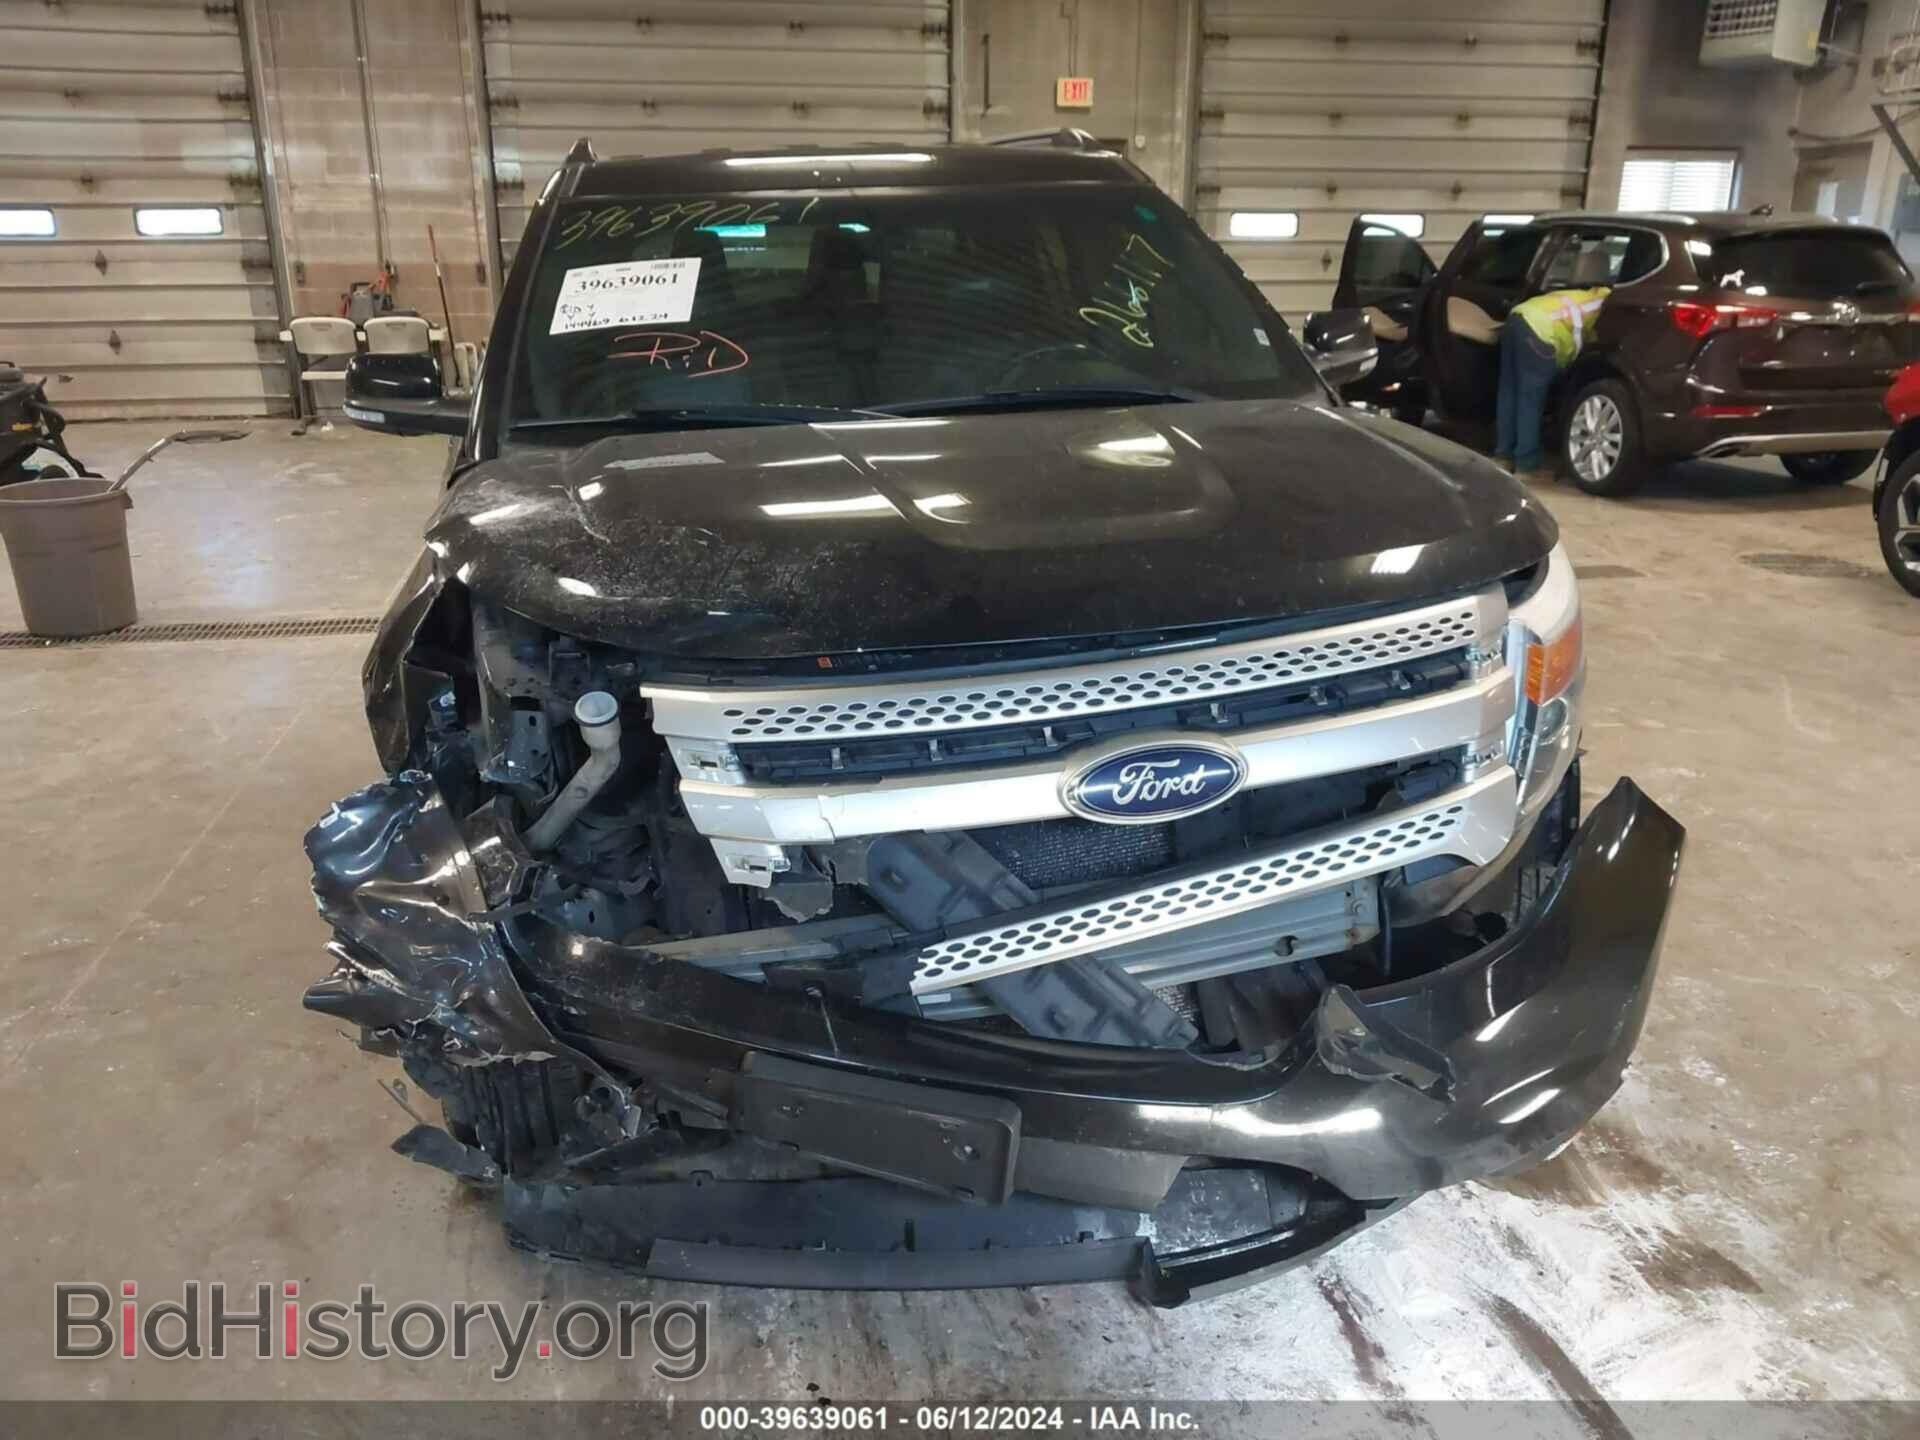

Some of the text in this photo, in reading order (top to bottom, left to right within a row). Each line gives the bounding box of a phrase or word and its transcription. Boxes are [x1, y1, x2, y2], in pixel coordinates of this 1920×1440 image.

[1064, 81, 1088, 100] EXIT
[575, 273, 678, 293] 39639061
[1112, 758, 1206, 806] Ford
